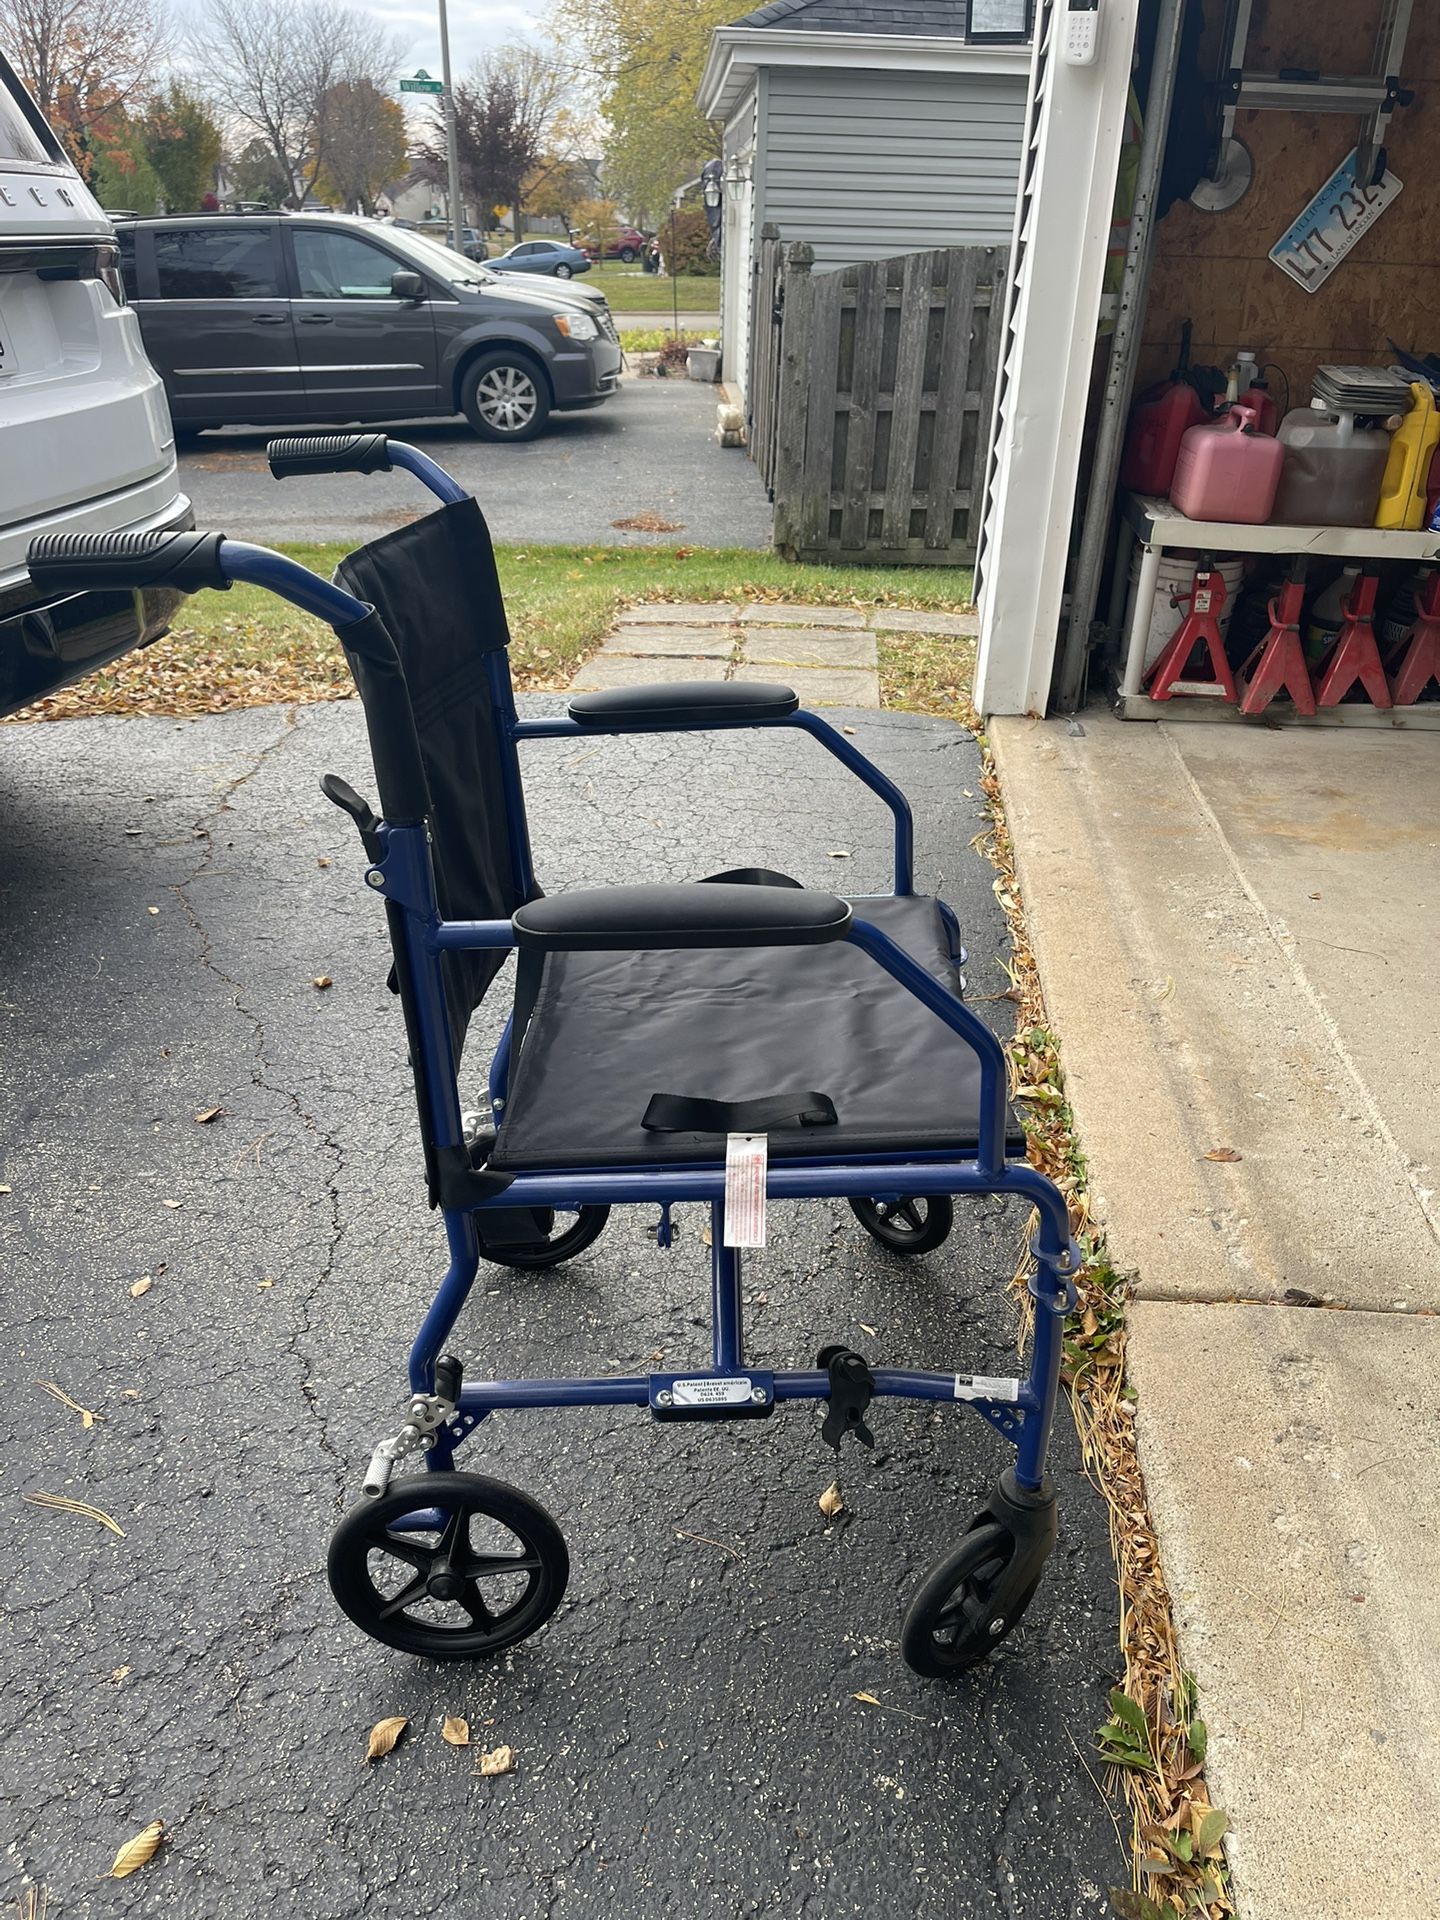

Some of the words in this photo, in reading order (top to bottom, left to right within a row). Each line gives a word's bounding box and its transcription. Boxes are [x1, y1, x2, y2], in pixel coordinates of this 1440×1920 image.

[1295, 179, 1342, 232] ILLINOIS
[1286, 227, 1334, 280] L77
[1331, 239, 1350, 260] LAND
[1346, 234, 1355, 244] OF
[1352, 209, 1375, 236] LINCOLN
